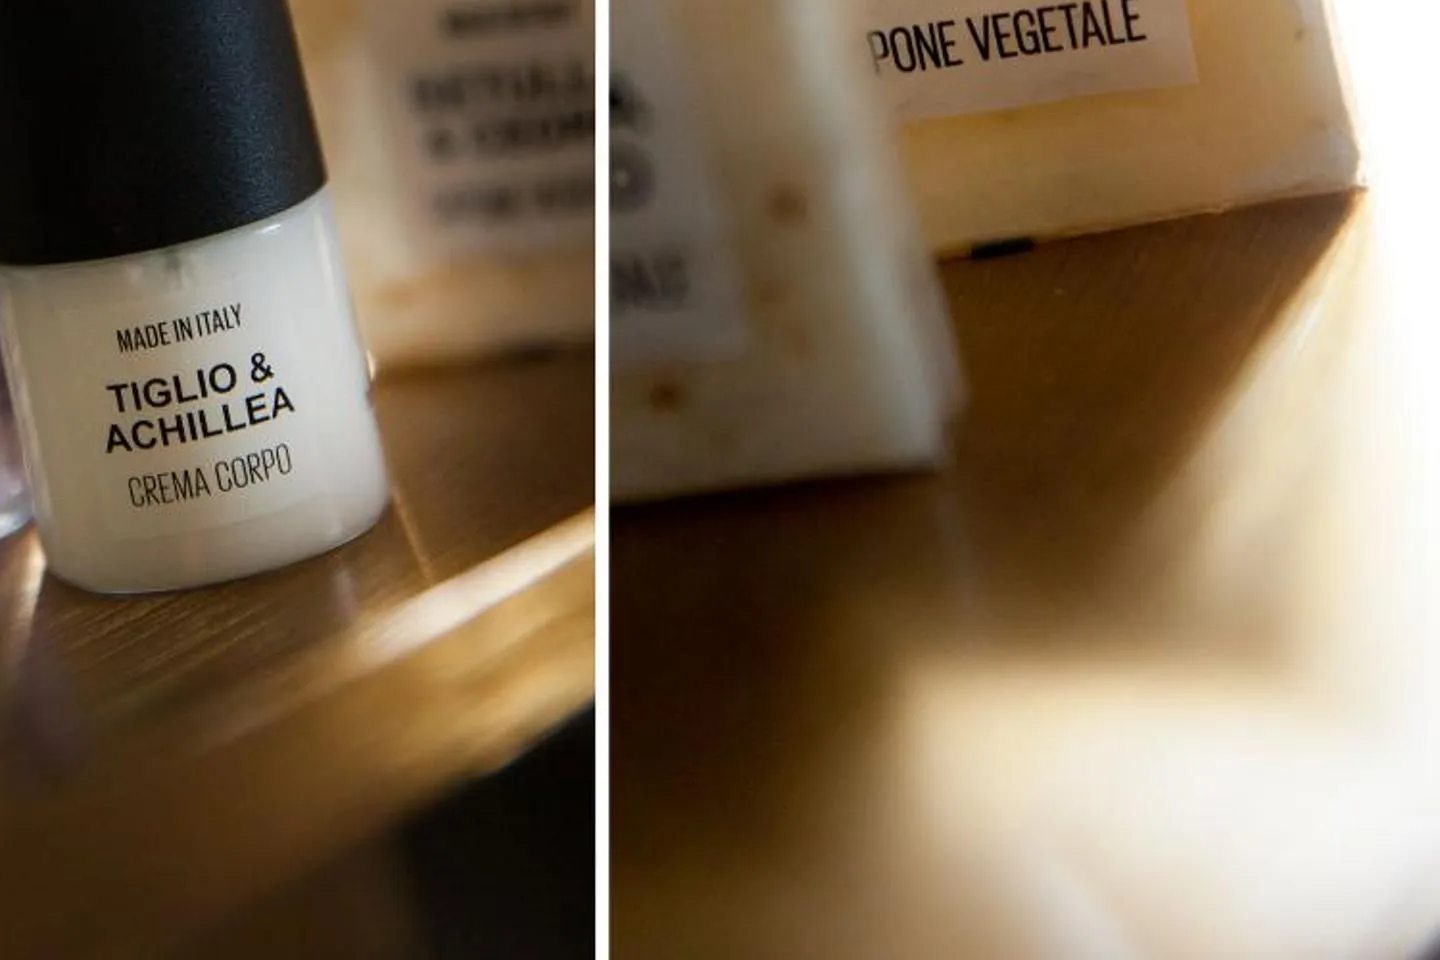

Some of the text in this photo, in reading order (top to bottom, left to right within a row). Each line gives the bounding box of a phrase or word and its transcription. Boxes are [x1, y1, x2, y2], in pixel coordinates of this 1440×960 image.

[868, 20, 963, 75] PONE
[116, 302, 242, 353] MADE IN ITALY
[106, 352, 274, 413] TIGLIO &
[105, 386, 295, 454] ACHILLEA
[128, 443, 293, 508] CREMA CORPO
